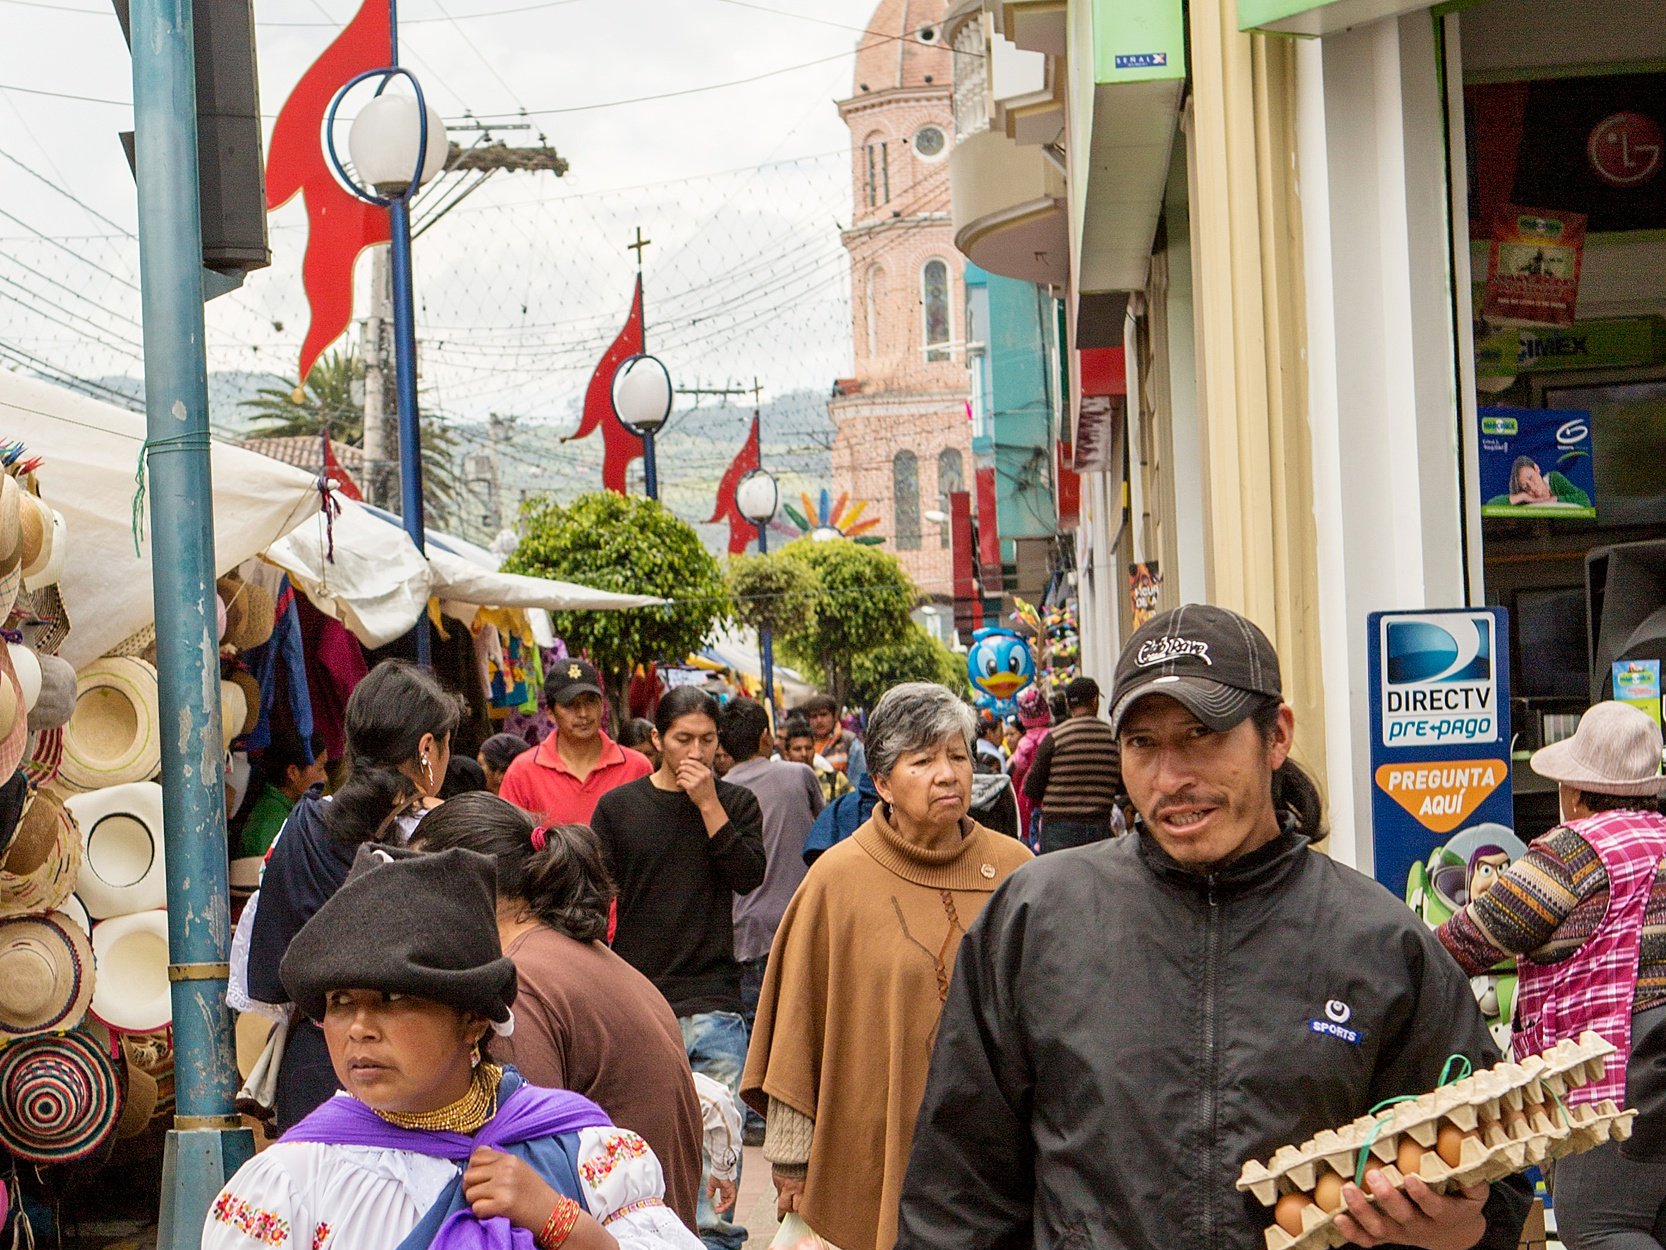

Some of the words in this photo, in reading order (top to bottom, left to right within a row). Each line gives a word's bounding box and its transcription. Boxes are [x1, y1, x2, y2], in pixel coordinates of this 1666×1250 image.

[1592, 114, 1660, 182] LG
[1387, 687, 1490, 713] DIRECTV
[1387, 766, 1496, 792] PREGUNTA
[1418, 787, 1466, 817] AQUÍ
[1312, 1021, 1357, 1042] SPORTS
